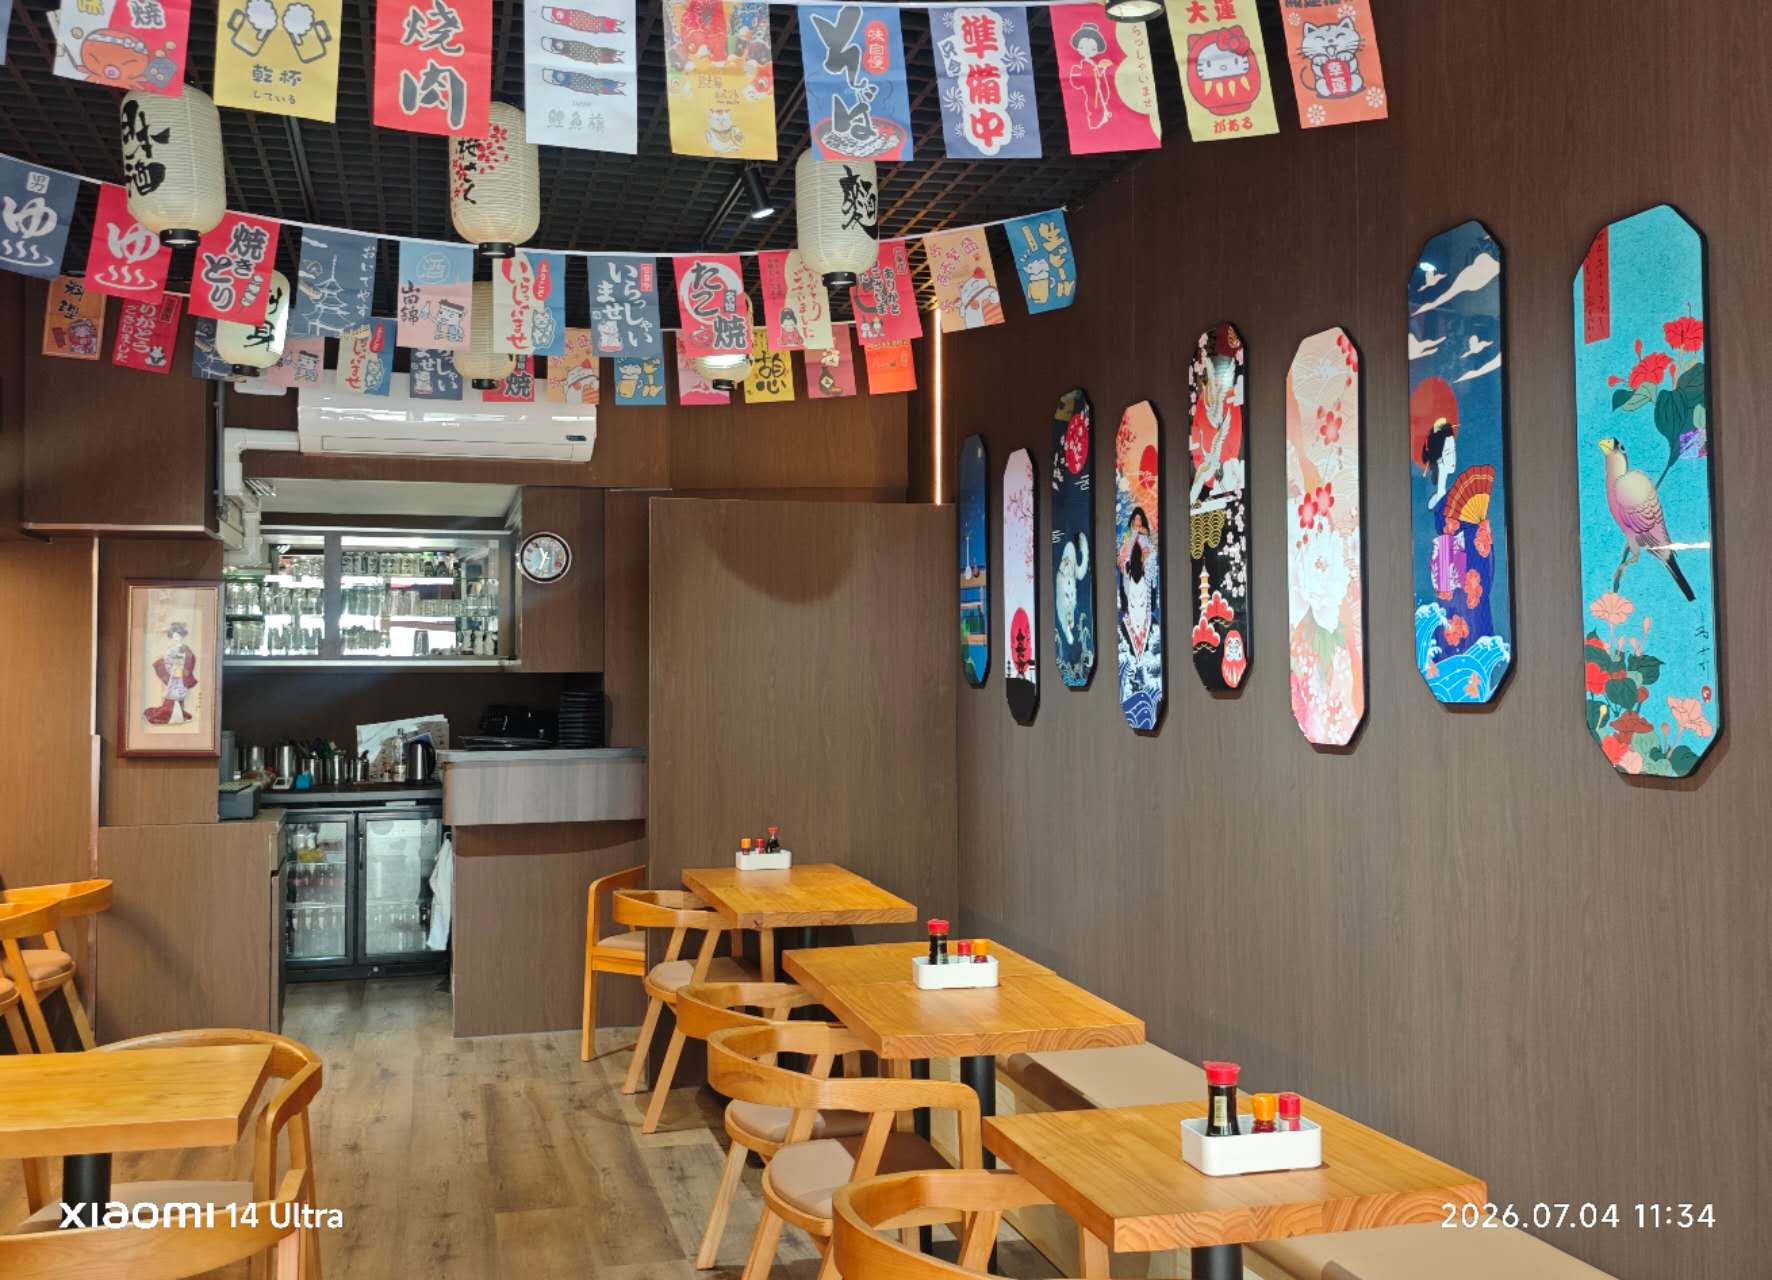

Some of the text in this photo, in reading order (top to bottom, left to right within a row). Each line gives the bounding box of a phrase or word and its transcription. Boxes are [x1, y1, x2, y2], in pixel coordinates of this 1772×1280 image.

[252, 64, 302, 85] 乾杯
[401, 0, 466, 129] 焼肉
[809, 5, 879, 141] そば
[961, 15, 1006, 148] 準備中
[253, 93, 297, 105] している
[1213, 118, 1253, 134] がある
[31, 175, 46, 192] 男
[2, 196, 58, 239] ゆ
[106, 222, 161, 264] ゆ
[228, 222, 269, 278] 焼き
[202, 253, 236, 312] とり
[355, 246, 376, 316] おいでやす
